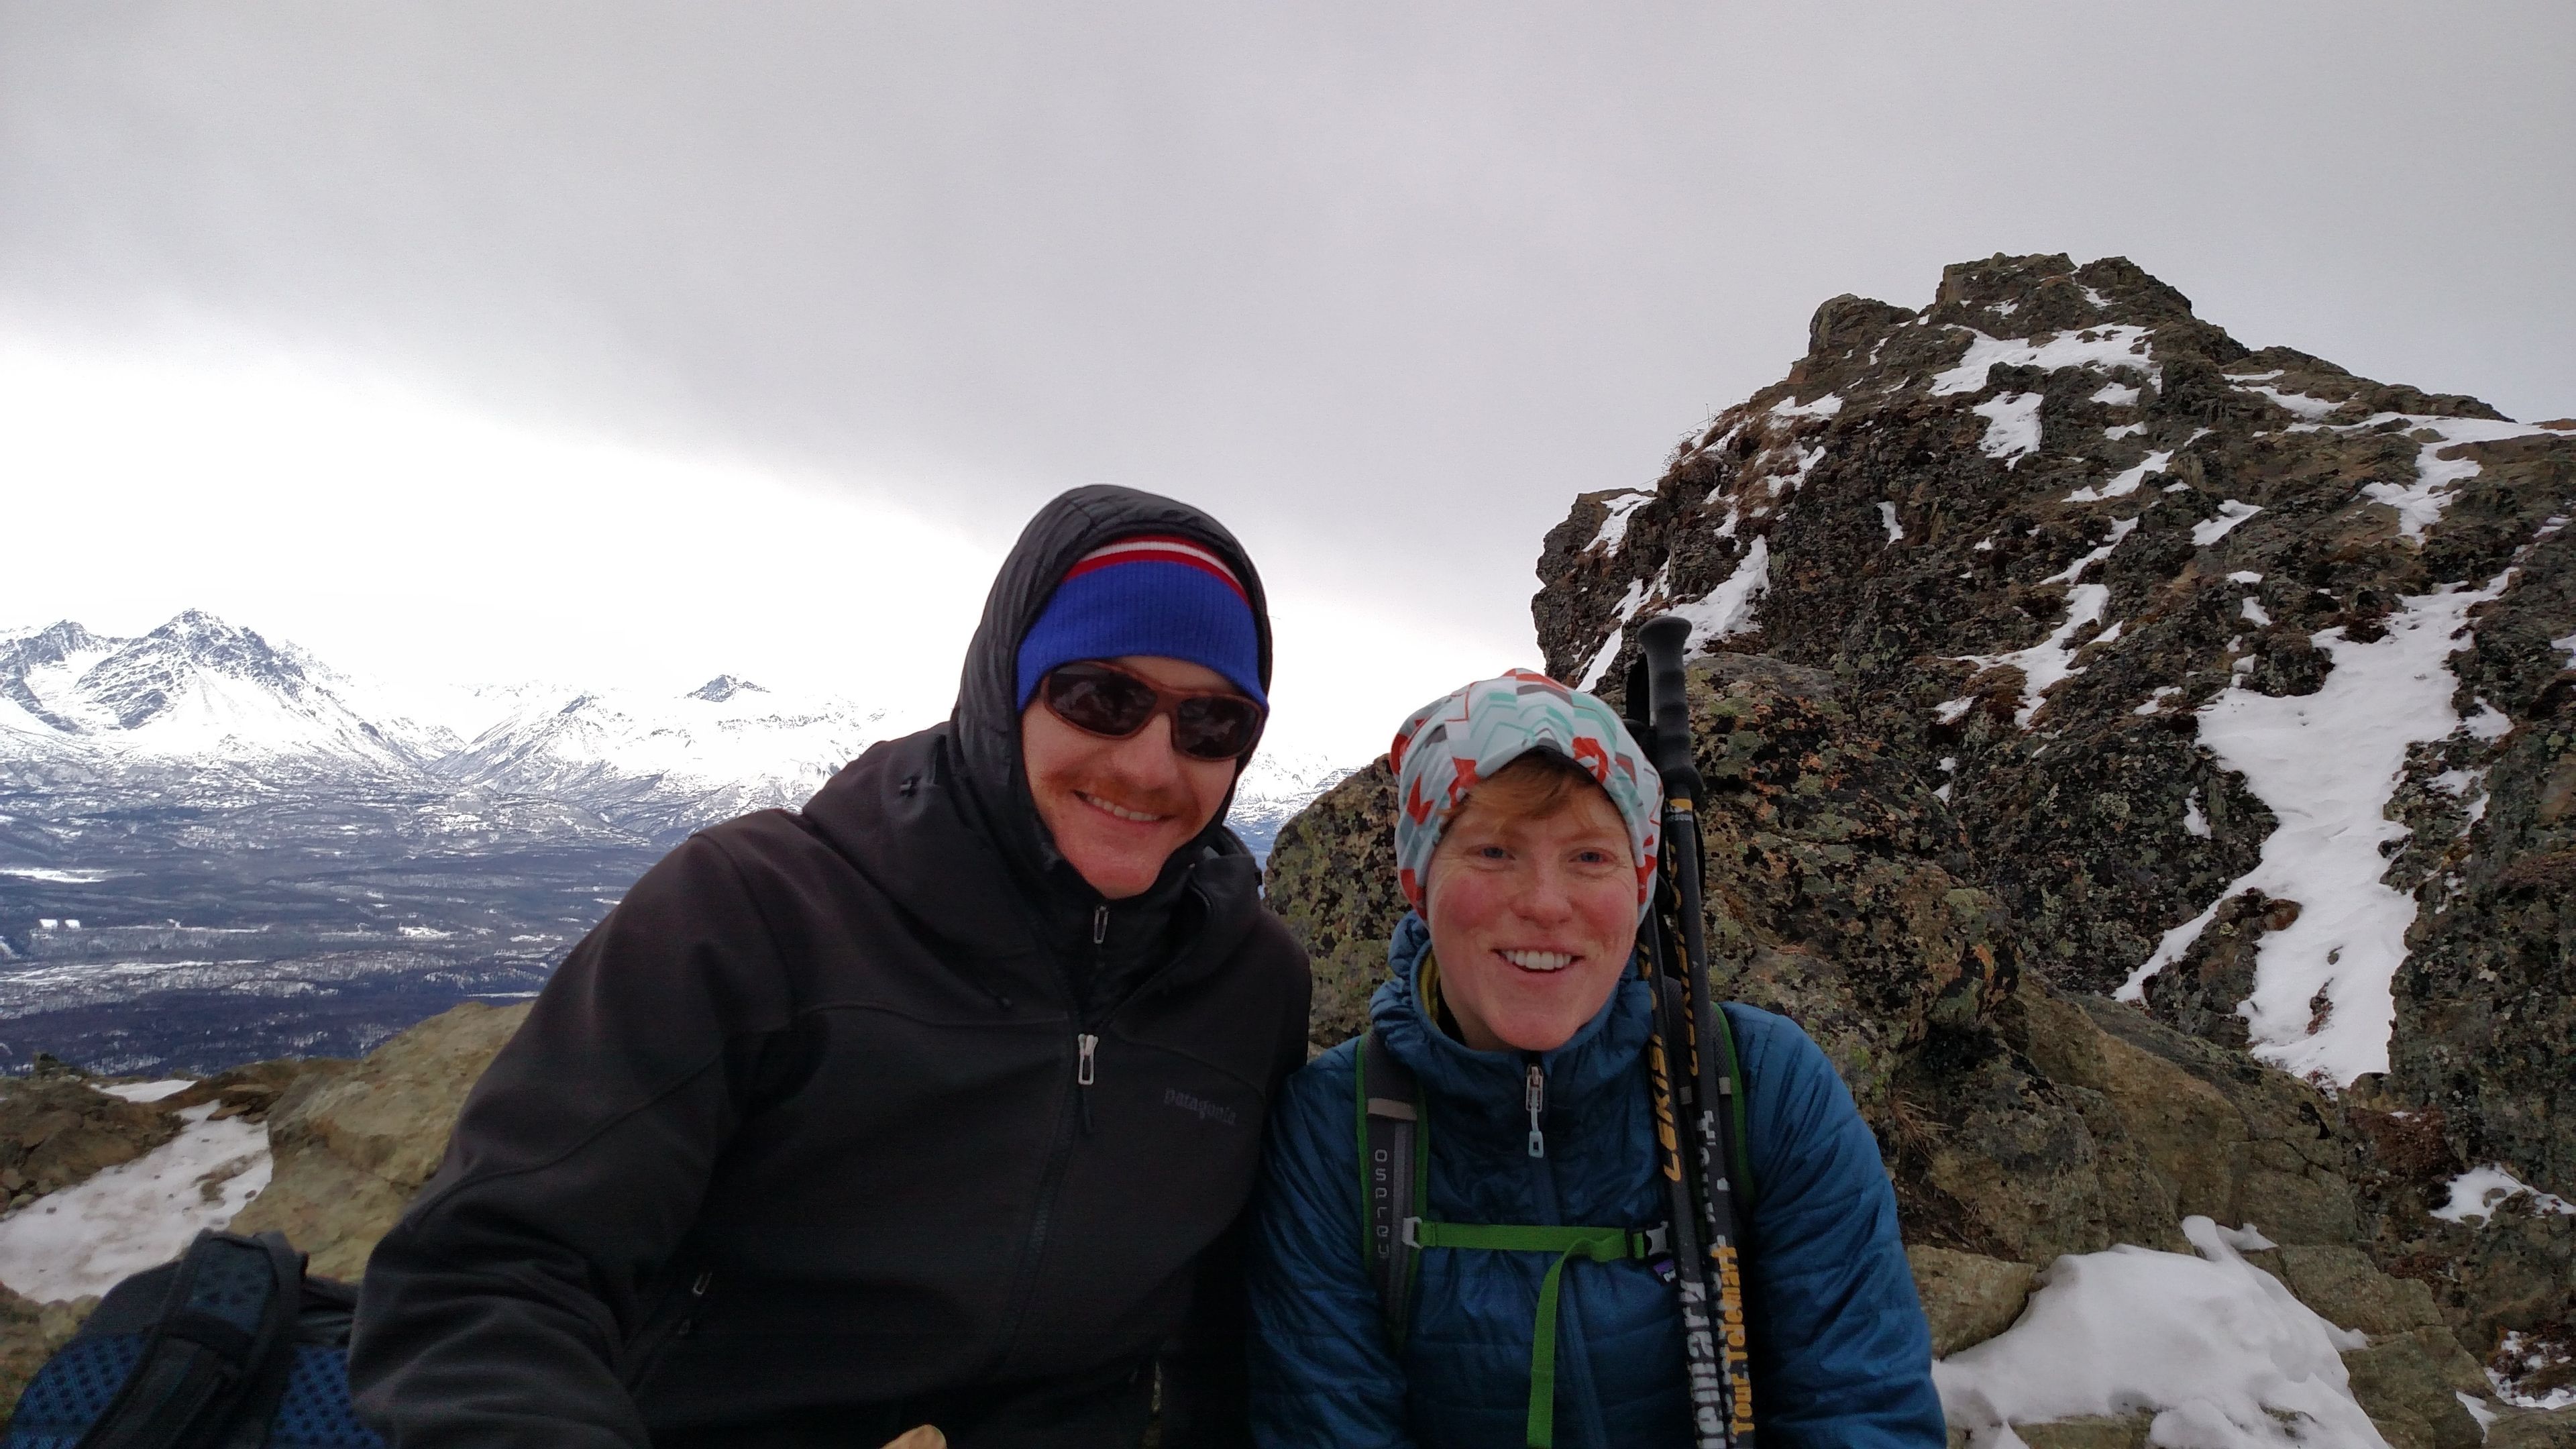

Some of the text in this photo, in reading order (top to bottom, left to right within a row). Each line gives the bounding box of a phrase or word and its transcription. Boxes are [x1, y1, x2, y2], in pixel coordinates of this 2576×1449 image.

[1163, 1087, 1236, 1125] patagonia
[1711, 1246, 1748, 1363] Telemark
[1730, 1373, 1755, 1436] Tour
